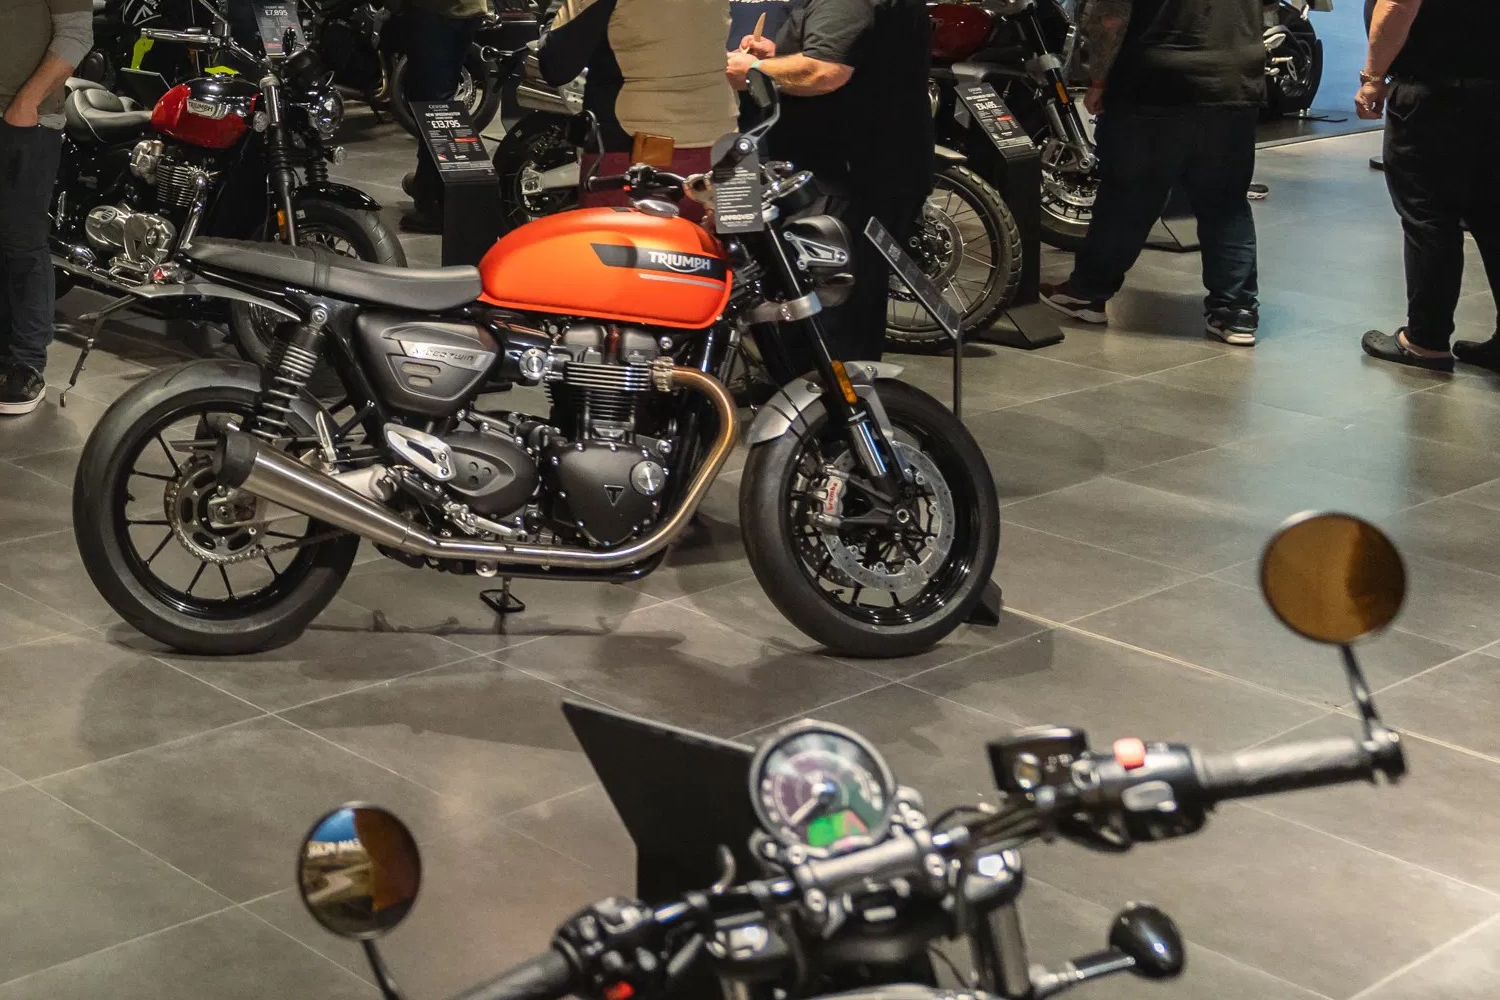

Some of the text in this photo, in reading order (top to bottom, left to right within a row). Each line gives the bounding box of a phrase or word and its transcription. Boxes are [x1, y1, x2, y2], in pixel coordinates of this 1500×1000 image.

[189, 101, 214, 113] TRIUMPH
[431, 120, 462, 129] £13,795
[648, 251, 712, 272] TRIUMPH
